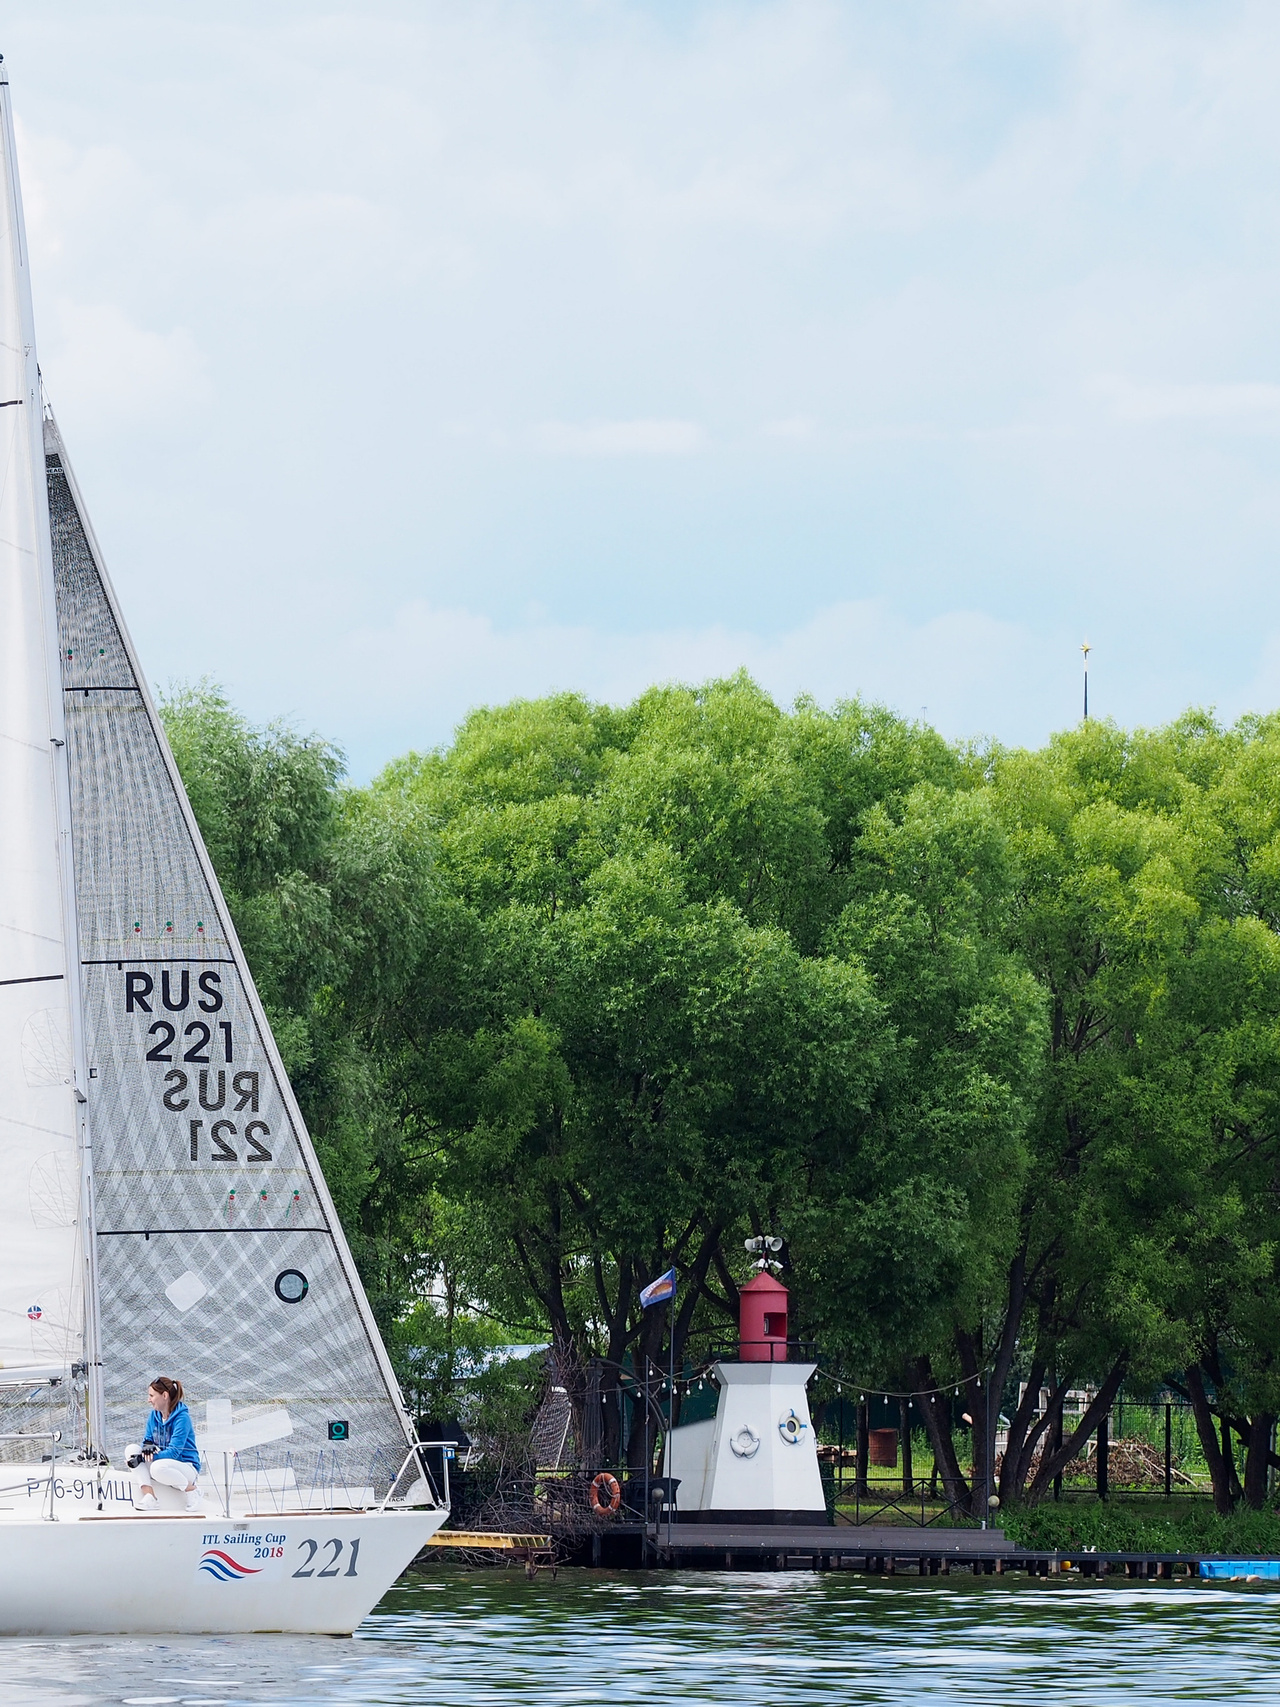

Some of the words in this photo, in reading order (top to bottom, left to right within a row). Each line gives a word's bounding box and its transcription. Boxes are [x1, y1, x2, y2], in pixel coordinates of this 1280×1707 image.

[125, 970, 223, 1014] RUS
[145, 1020, 233, 1063] 221
[202, 1534, 221, 1545] ITL
[223, 1533, 262, 1546] Sailing
[265, 1532, 287, 1546] Cup
[253, 1546, 284, 1559] 2018
[291, 1537, 361, 1579] 221
